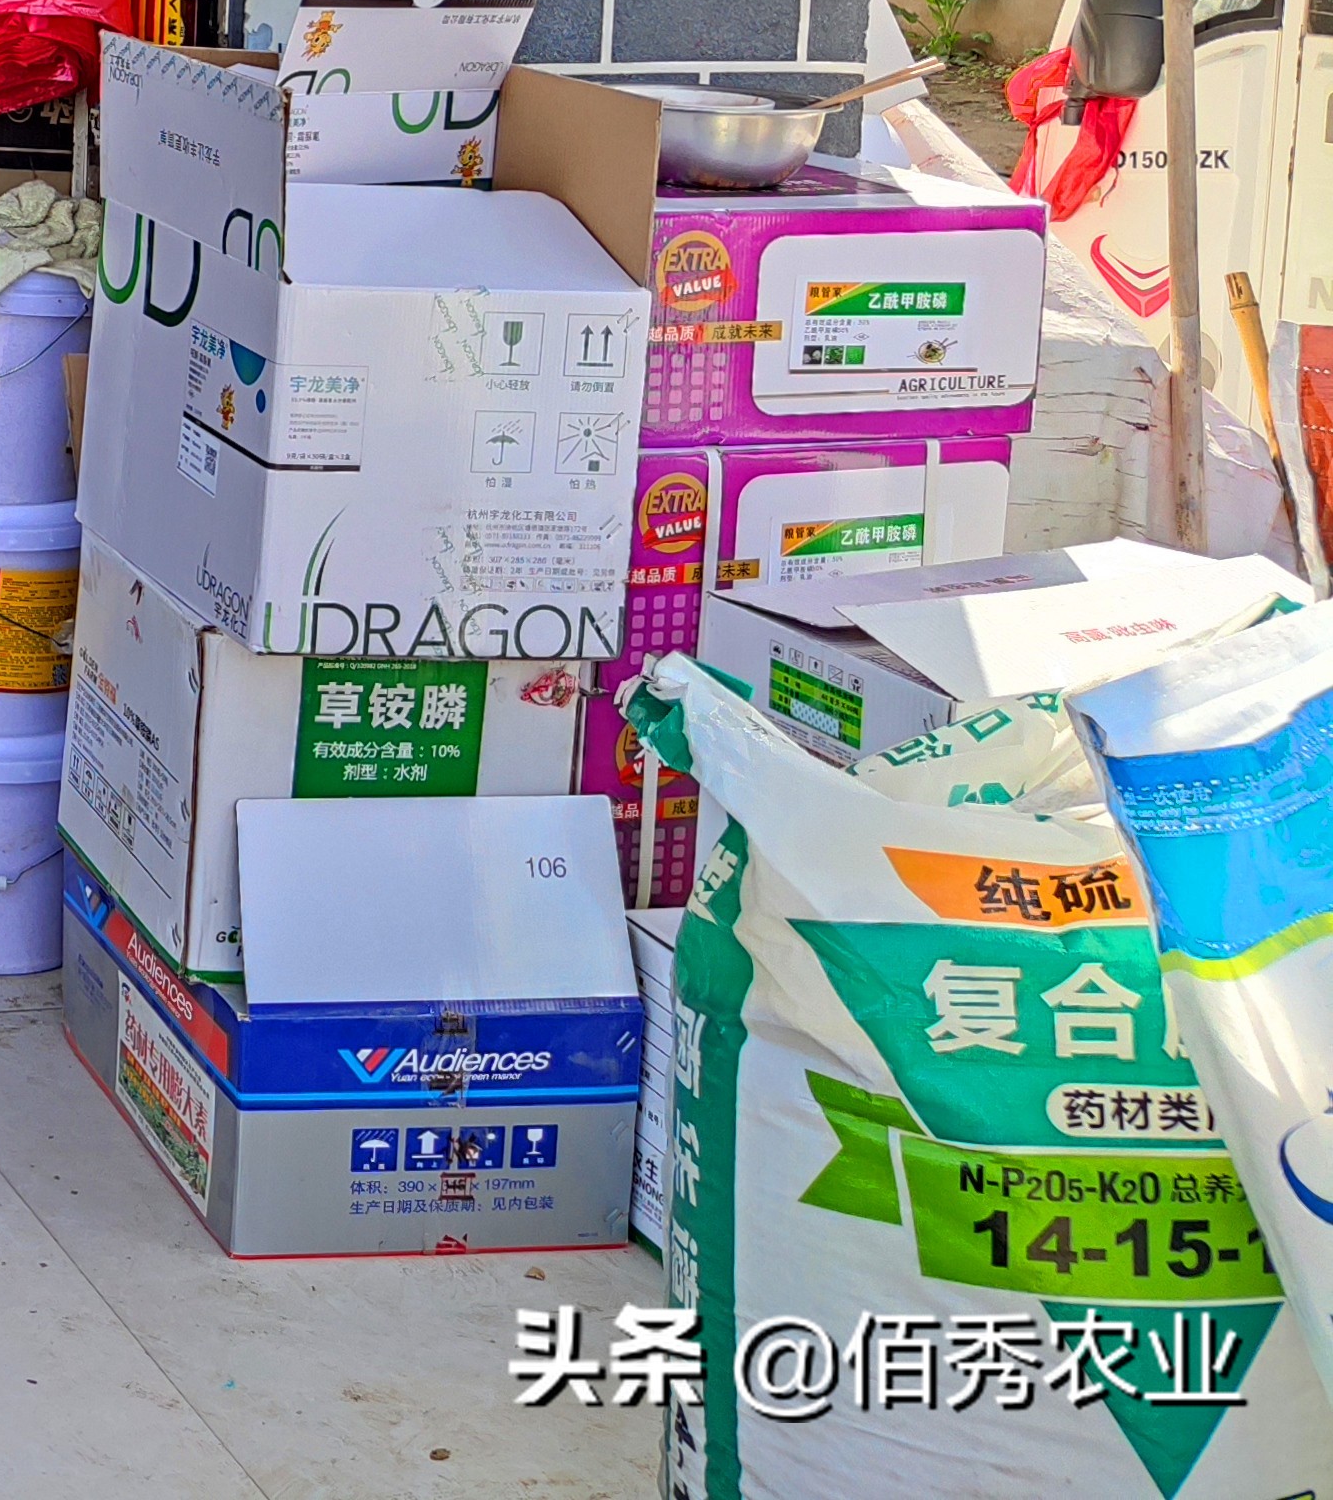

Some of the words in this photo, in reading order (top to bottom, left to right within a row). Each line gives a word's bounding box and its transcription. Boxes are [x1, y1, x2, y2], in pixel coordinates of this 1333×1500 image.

[664, 244, 728, 275] EXTRA
[671, 273, 723, 299] VALUE
[868, 291, 947, 311] 乙酰甲胺磷
[711, 321, 774, 340] 成就未来
[191, 325, 227, 360] 宇龙美净
[289, 375, 360, 394] 宇龙美净
[485, 379, 530, 391] 小心轻放
[570, 381, 615, 393] 请勿倒置
[899, 375, 1006, 394] AGRICULTURE
[569, 478, 596, 490] 怕热
[646, 488, 706, 516] EXTRA
[466, 510, 578, 522] 杭州宇龙化工有限公司
[653, 516, 703, 539] VALUE
[841, 523, 917, 545] 乙酰甲胺磷
[263, 600, 627, 660] UDRAGON
[314, 681, 467, 731] 草铵膦
[313, 740, 461, 761] 有效成分含量：10%
[342, 762, 428, 784] 剂型：水剂
[524, 856, 568, 880] 106
[977, 864, 1132, 924] 纯硫
[127, 931, 194, 1022] Audiences
[393, 1046, 552, 1077] Audiences
[350, 1180, 388, 1195] 体积：
[397, 1181, 425, 1194] 390
[485, 1178, 536, 1192] 197mm
[349, 1195, 555, 1216] 生产日期及保质期：见内包装
